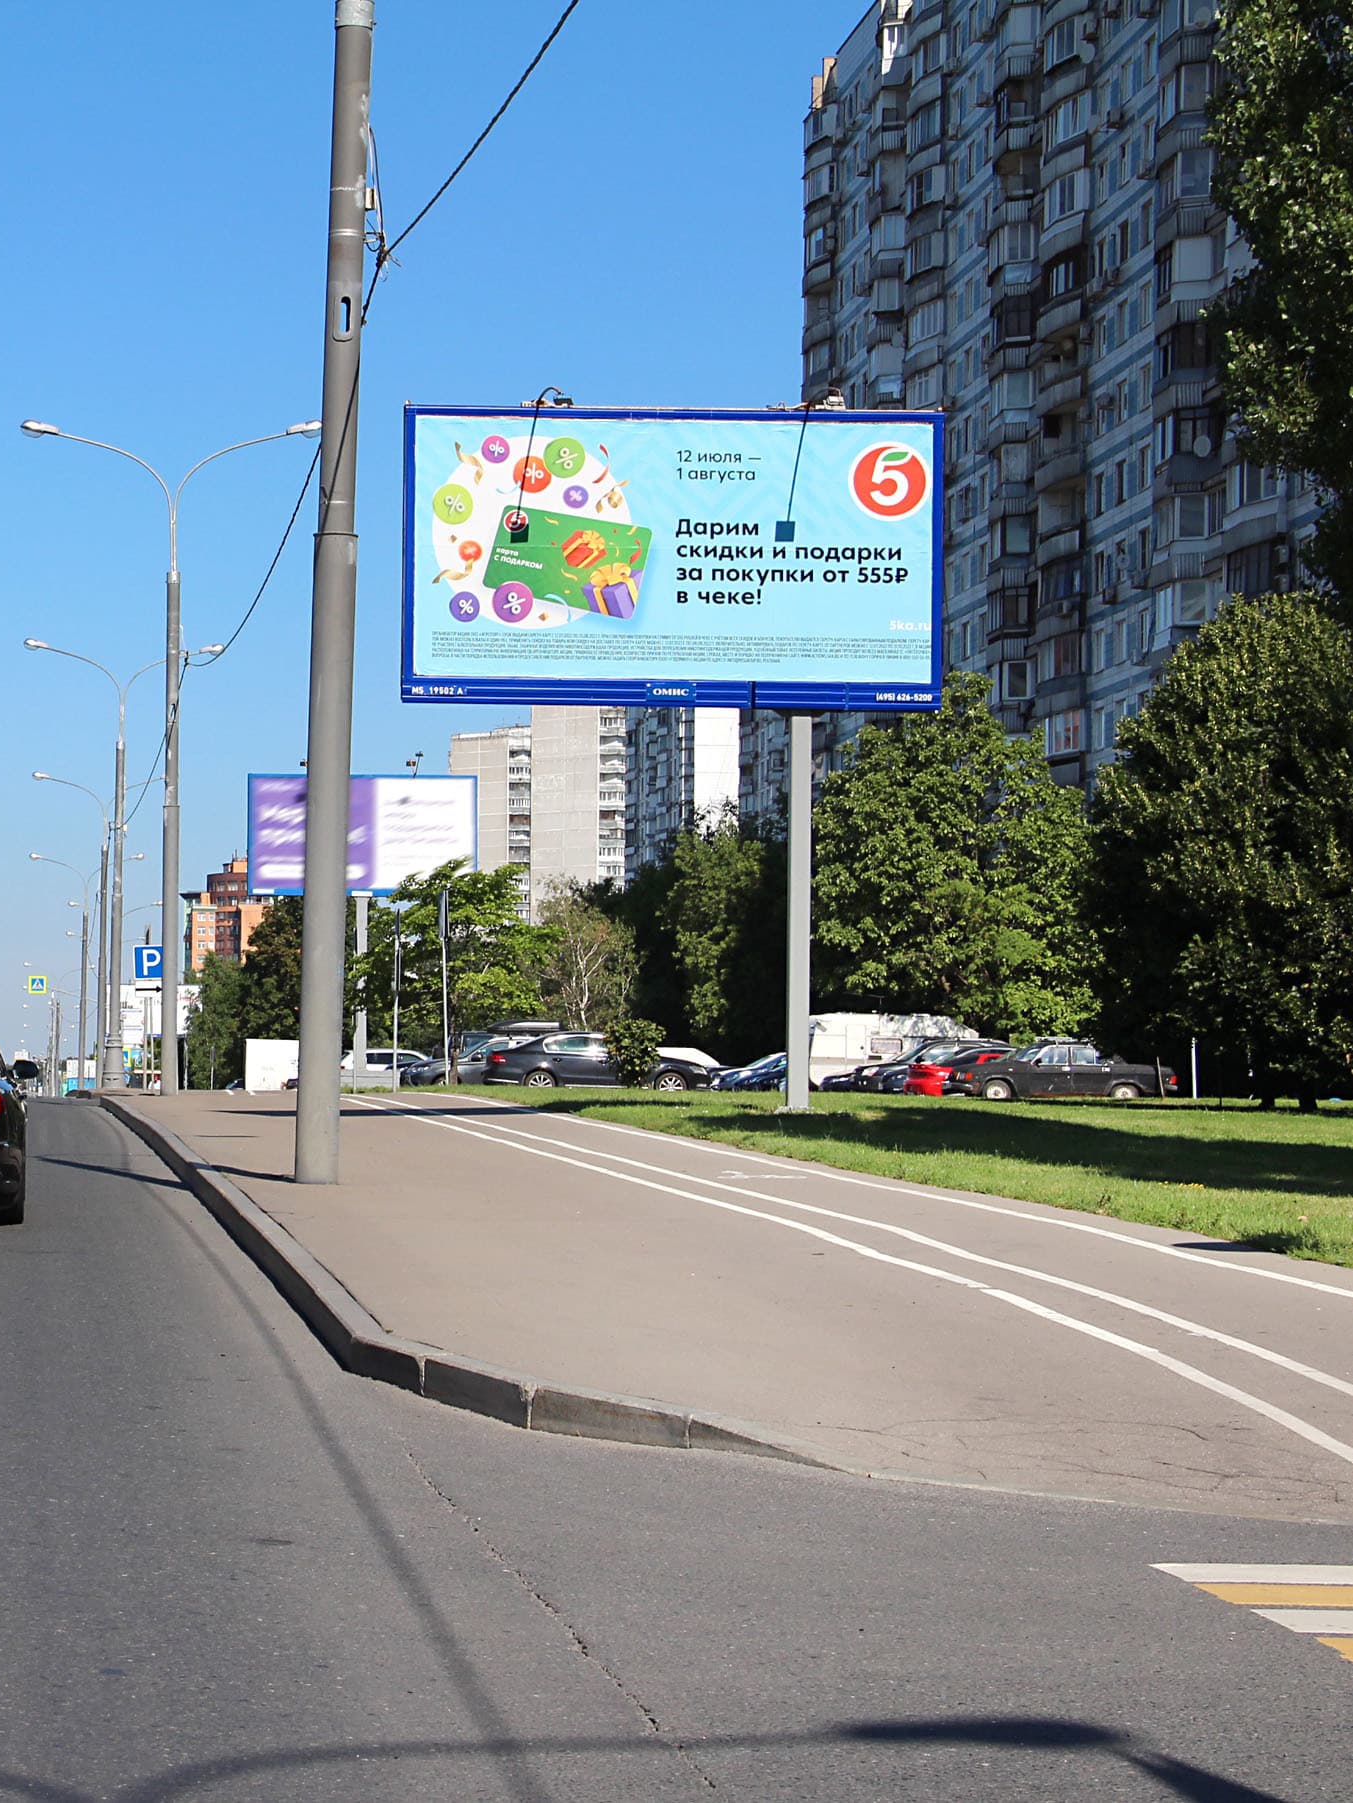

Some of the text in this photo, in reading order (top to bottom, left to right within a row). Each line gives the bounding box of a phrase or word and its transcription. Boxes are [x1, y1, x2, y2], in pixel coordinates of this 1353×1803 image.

[676, 449, 692, 463] 12
[697, 452, 743, 464] июля
[676, 467, 756, 484] 1 августа
[675, 518, 759, 539] Дарим
[676, 543, 902, 565] скидки и подарки
[676, 566, 703, 581] за
[711, 567, 814, 586] покупки
[823, 569, 849, 583] от
[676, 588, 761, 605] в чеке!
[889, 618, 932, 631] 5ka.ru
[652, 688, 690, 697] ОМИС
[142, 949, 161, 976] P
